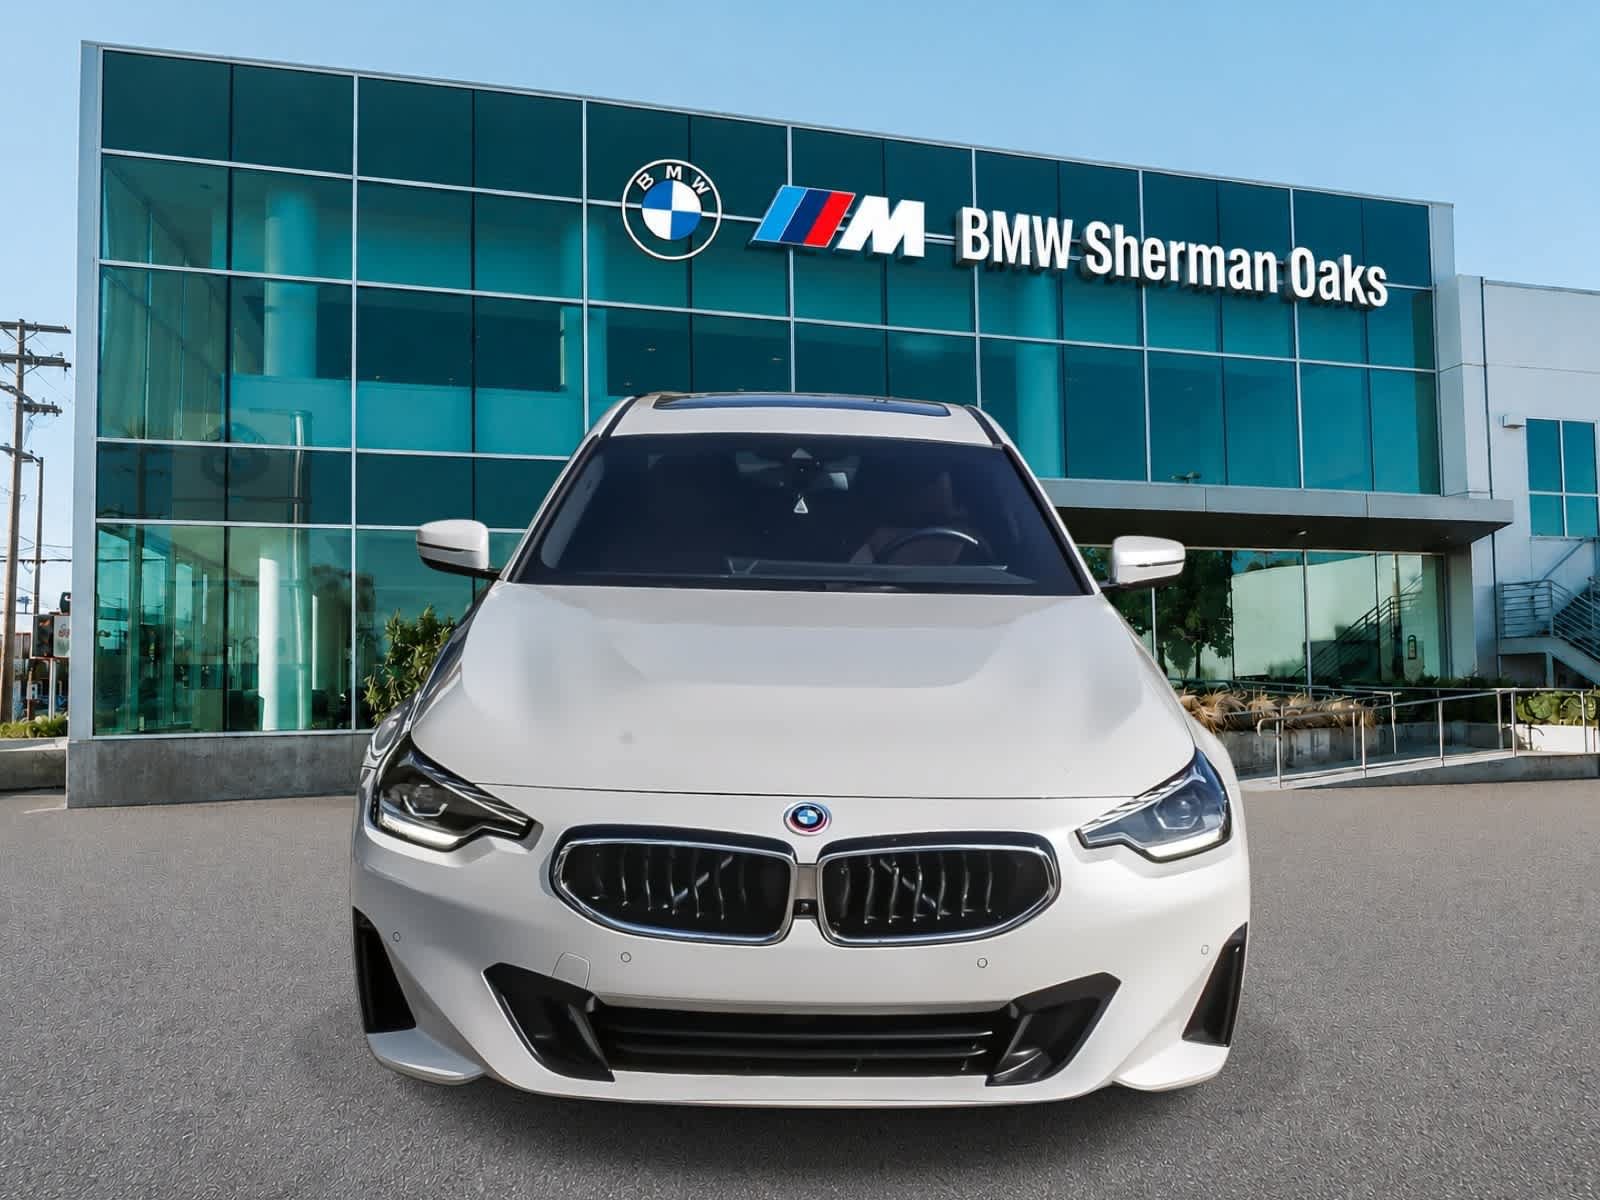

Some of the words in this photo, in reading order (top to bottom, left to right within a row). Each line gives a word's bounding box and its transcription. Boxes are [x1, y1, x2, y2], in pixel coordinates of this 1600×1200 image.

[636, 165, 709, 195] BMW
[836, 195, 925, 258] M
[961, 206, 1073, 271] BMW
[1085, 221, 1279, 294] Sherman
[1290, 246, 1389, 307] Oaks
